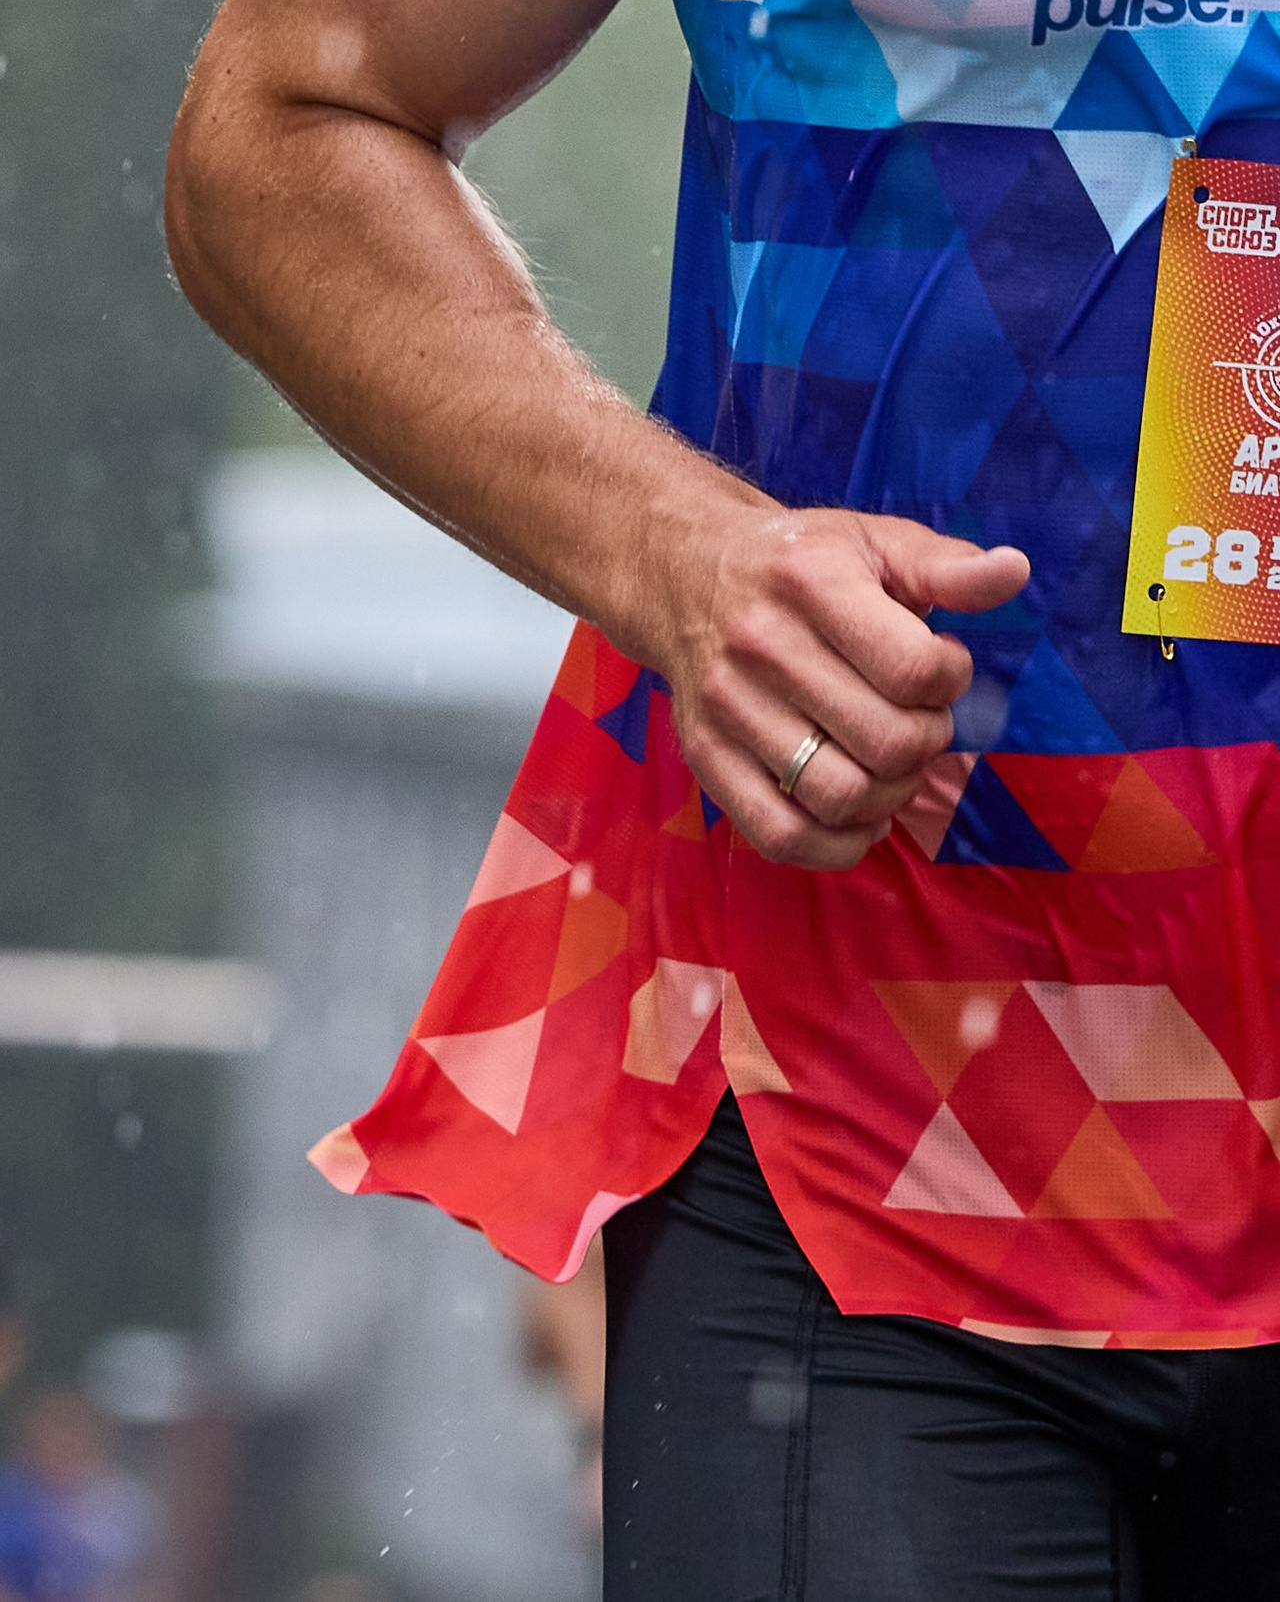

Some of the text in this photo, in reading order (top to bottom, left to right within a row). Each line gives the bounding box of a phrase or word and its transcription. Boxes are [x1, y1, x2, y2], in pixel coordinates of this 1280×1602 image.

[1202, 205, 1272, 229] СПОРТ
[1212, 227, 1278, 252] СОЮЗ
[1163, 525, 1261, 586] 28
